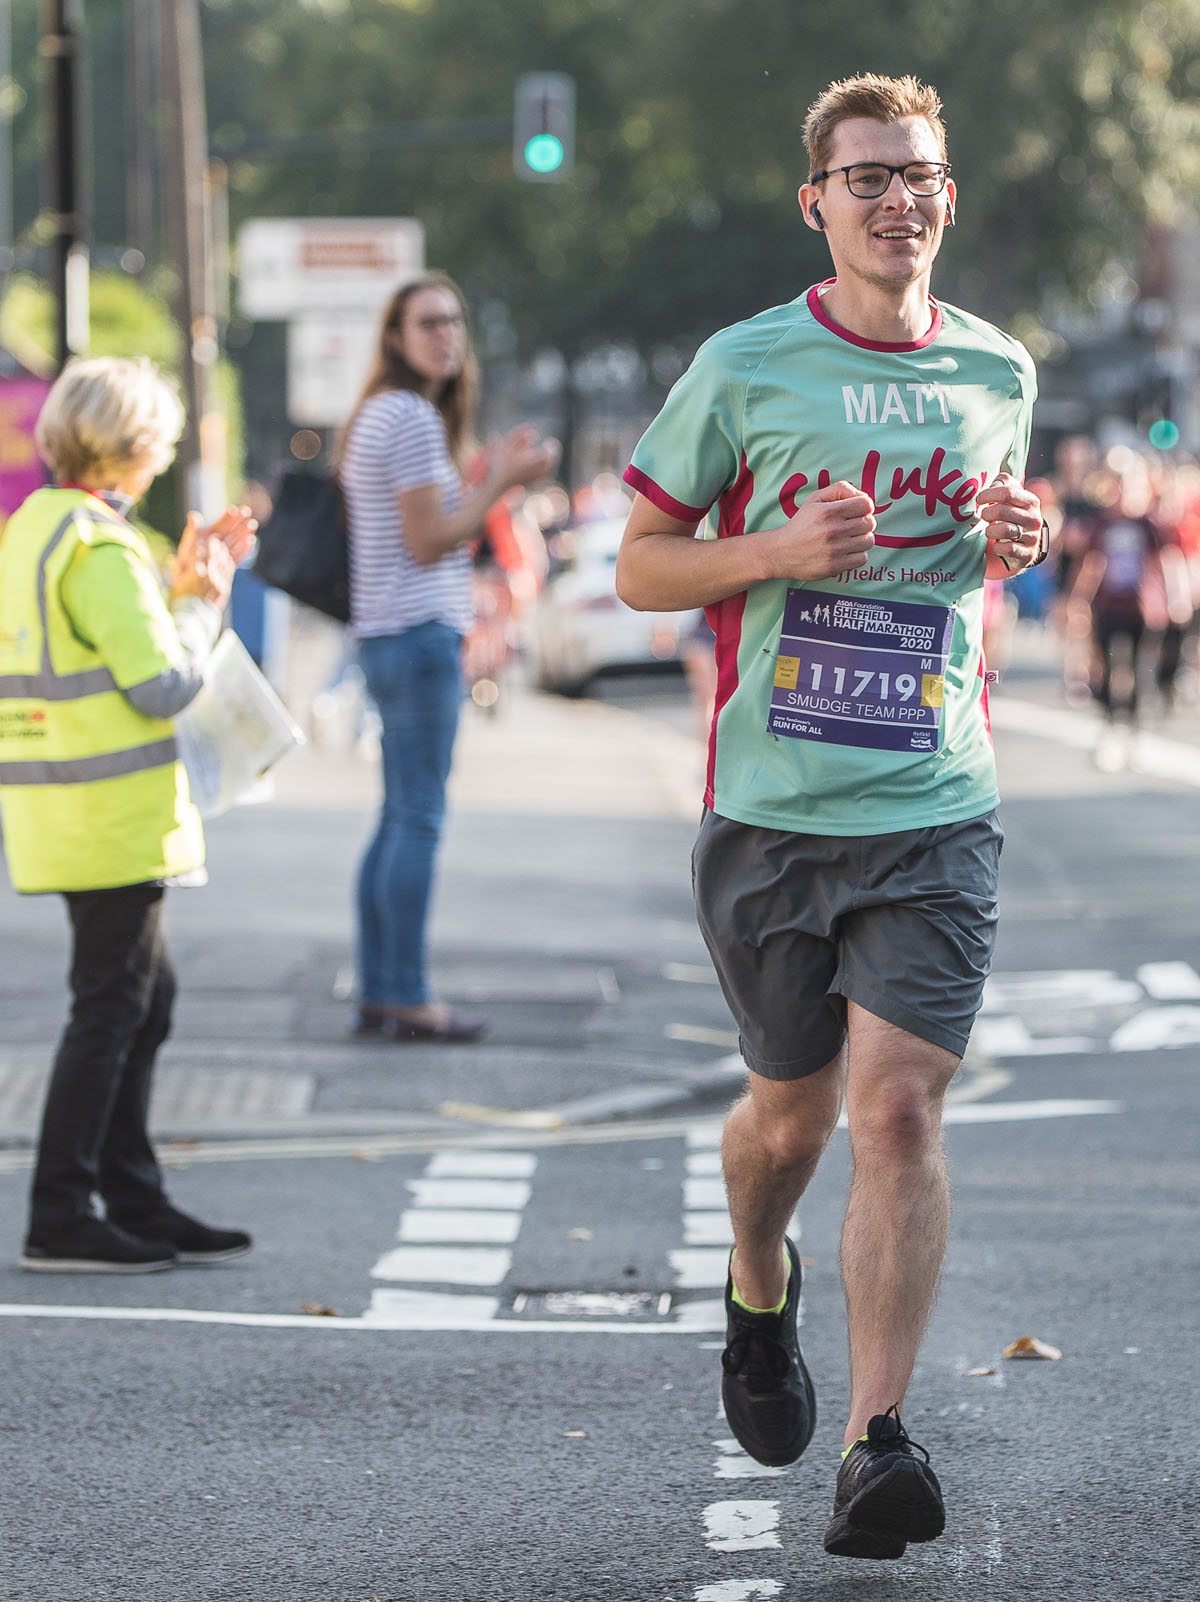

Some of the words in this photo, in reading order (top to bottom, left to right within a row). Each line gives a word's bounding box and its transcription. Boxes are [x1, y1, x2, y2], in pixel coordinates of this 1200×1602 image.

[841, 383, 952, 424] MATT
[860, 447, 988, 523] Luke'
[900, 567, 956, 586] Hospice
[834, 606, 891, 622] SHEFFIELD
[833, 617, 864, 630] HALF
[865, 621, 934, 638] MARATHON
[900, 637, 932, 650] 2020
[920, 659, 932, 670] M
[811, 663, 916, 702] 11719
[787, 693, 851, 713] SMUDGE
[856, 703, 895, 719] TEAM
[898, 708, 926, 721] PPP
[773, 720, 790, 729] RUN
[791, 723, 807, 732] FOR
[808, 726, 822, 735] ALL
